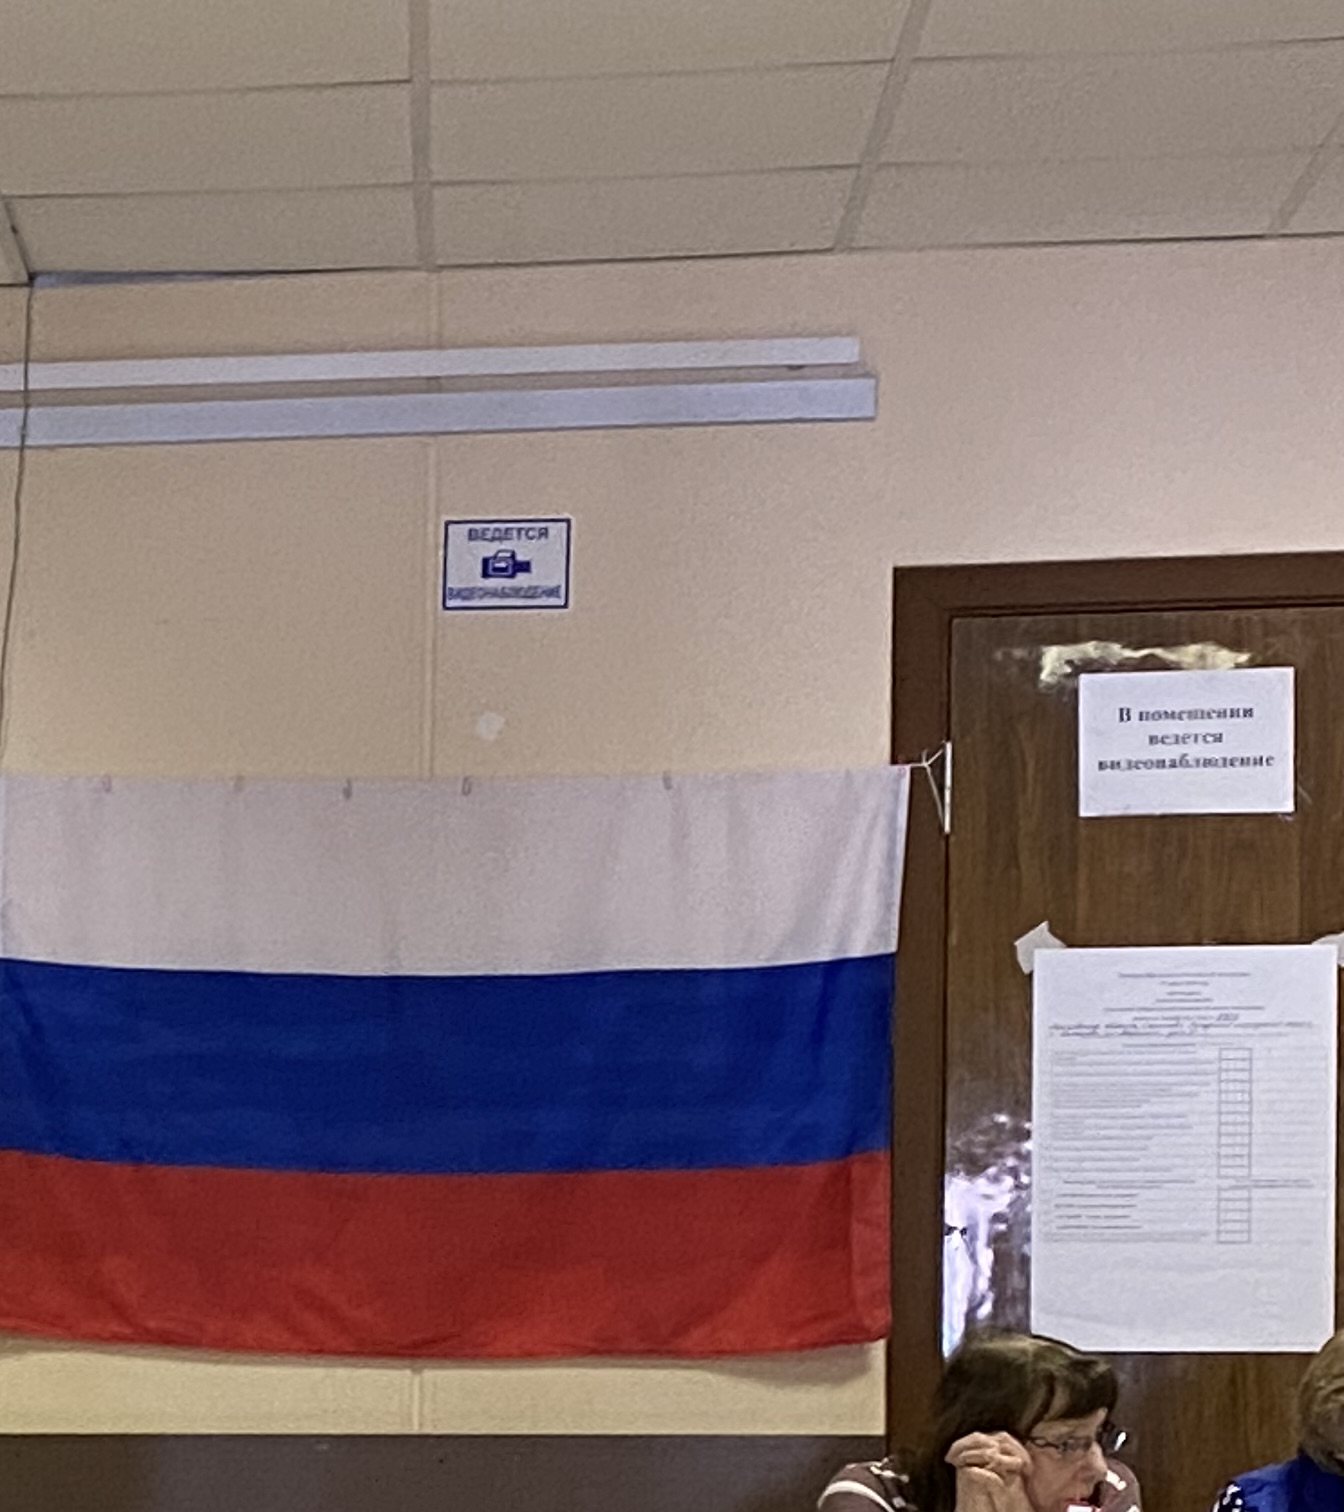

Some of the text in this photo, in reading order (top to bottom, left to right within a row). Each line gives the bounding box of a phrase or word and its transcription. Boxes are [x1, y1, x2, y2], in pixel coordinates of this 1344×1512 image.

[468, 527, 549, 543] ВЕДЕТСЯ
[1118, 705, 1255, 723] В помещении
[1148, 731, 1224, 746] ведется
[1097, 753, 1275, 772] видеонаблюдение
